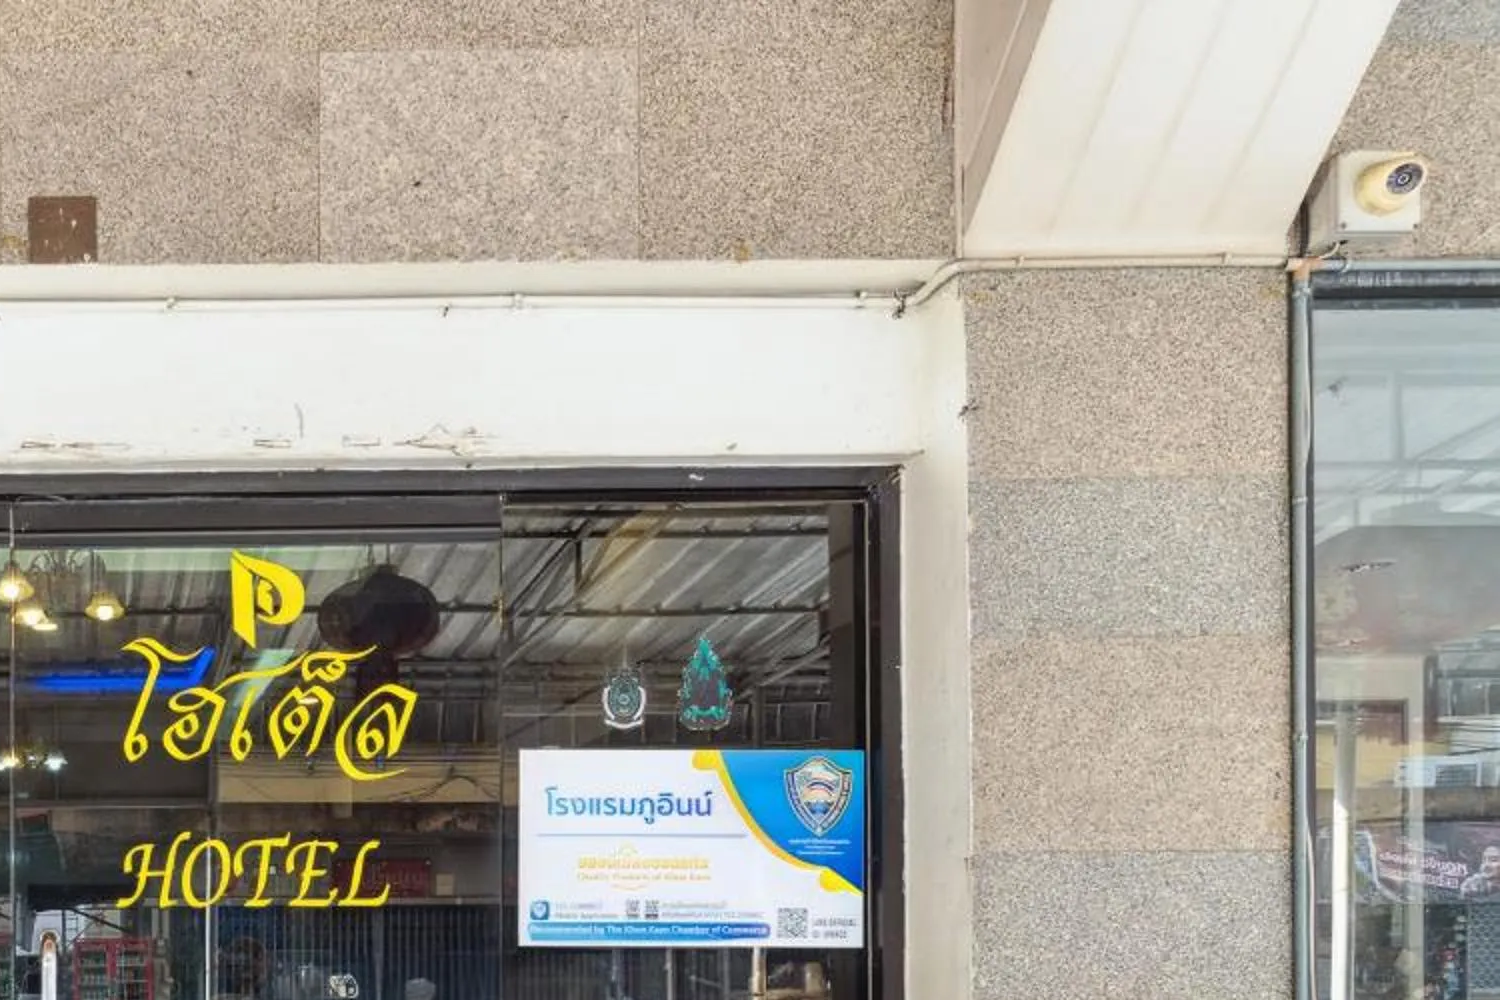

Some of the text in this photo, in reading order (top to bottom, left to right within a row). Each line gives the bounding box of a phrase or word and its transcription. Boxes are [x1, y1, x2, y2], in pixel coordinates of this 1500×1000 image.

[122, 637, 418, 782] โฮเต็ล
[545, 786, 713, 825] โรงแรมภูอินน์
[116, 830, 391, 909] HOTEL
